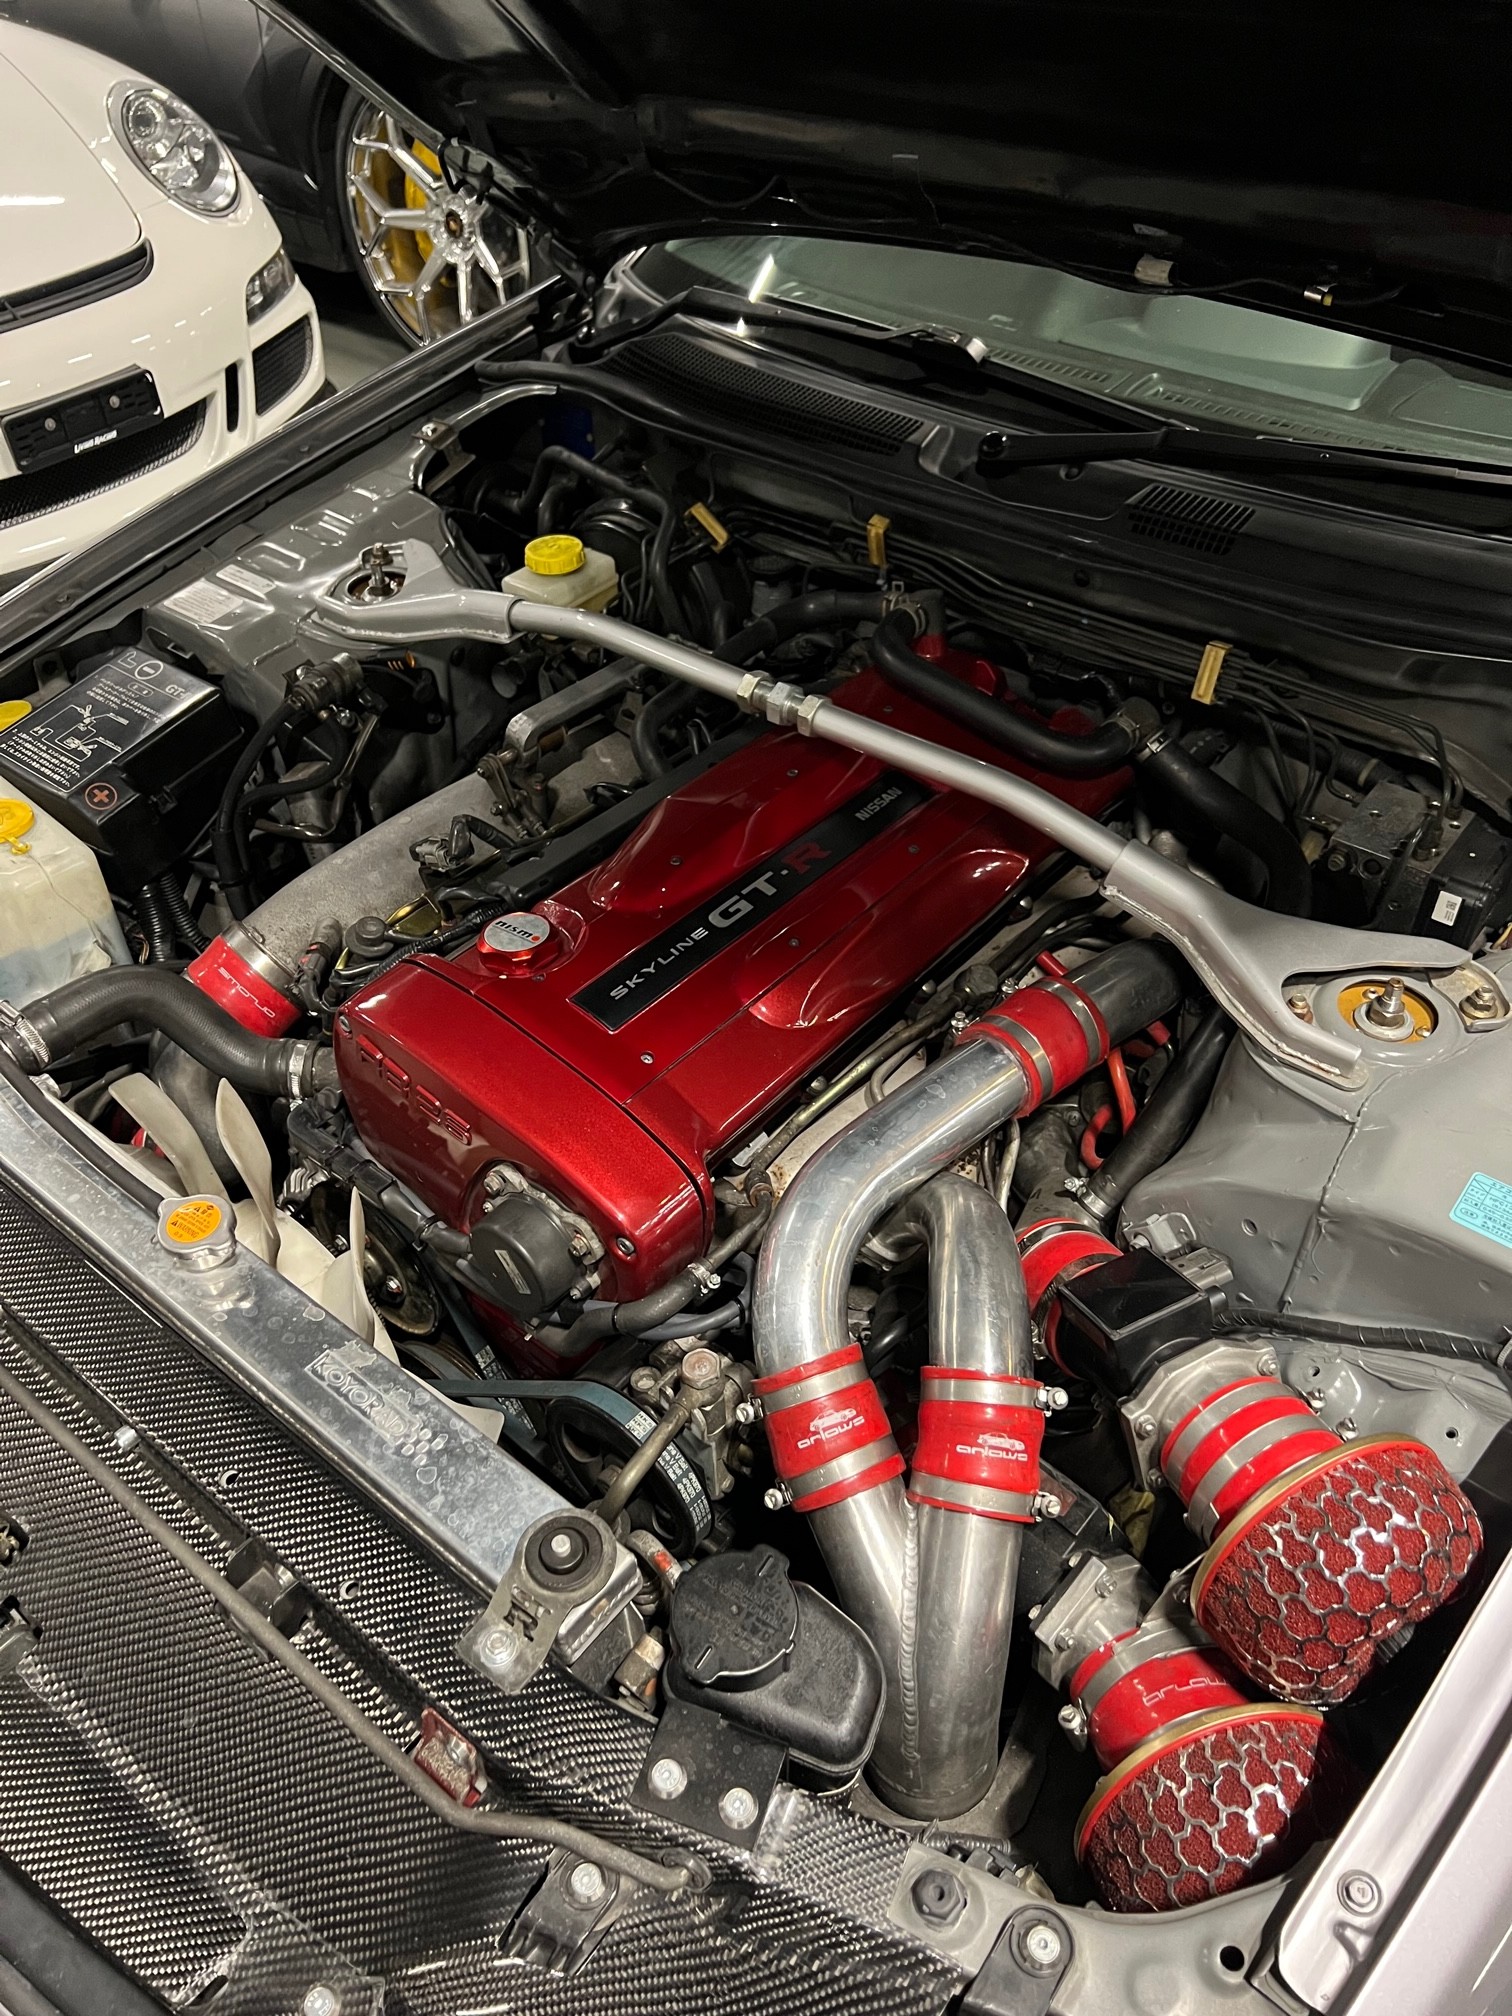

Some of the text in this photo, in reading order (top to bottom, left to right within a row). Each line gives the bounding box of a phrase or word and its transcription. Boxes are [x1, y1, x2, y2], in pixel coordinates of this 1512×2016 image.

[855, 786, 903, 821] NISSAN
[609, 926, 709, 1000] SKYLINE
[797, 1415, 865, 1449] arlows
[956, 1444, 1029, 1462] arlows
[1143, 1676, 1227, 1707] arlow
